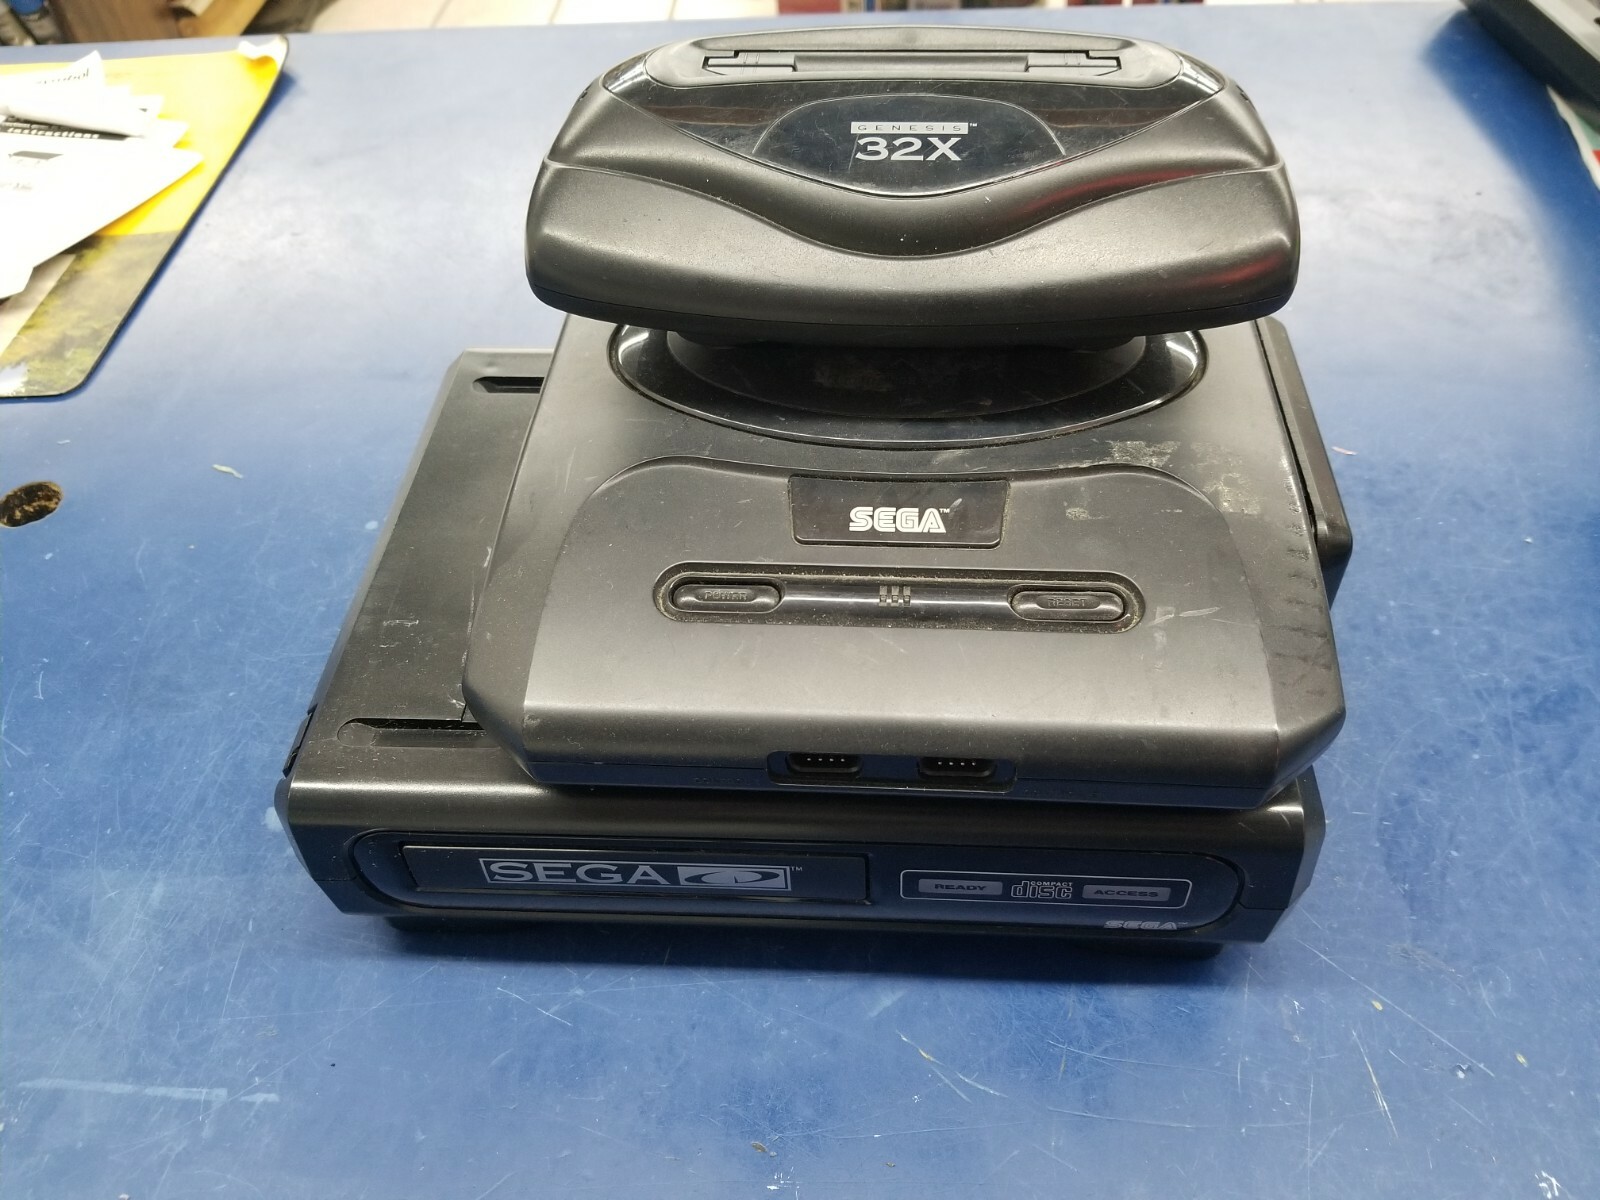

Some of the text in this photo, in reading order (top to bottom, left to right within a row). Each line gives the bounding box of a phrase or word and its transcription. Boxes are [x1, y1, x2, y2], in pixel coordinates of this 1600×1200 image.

[857, 124, 962, 132] GENESIS
[855, 136, 962, 161] 32X
[849, 506, 946, 533] SEGA
[704, 590, 748, 600] POWER
[1048, 598, 1087, 607] RESET
[489, 862, 671, 884] SEGA
[1094, 889, 1159, 897] ACCESS
[1104, 920, 1177, 930] SEGA
